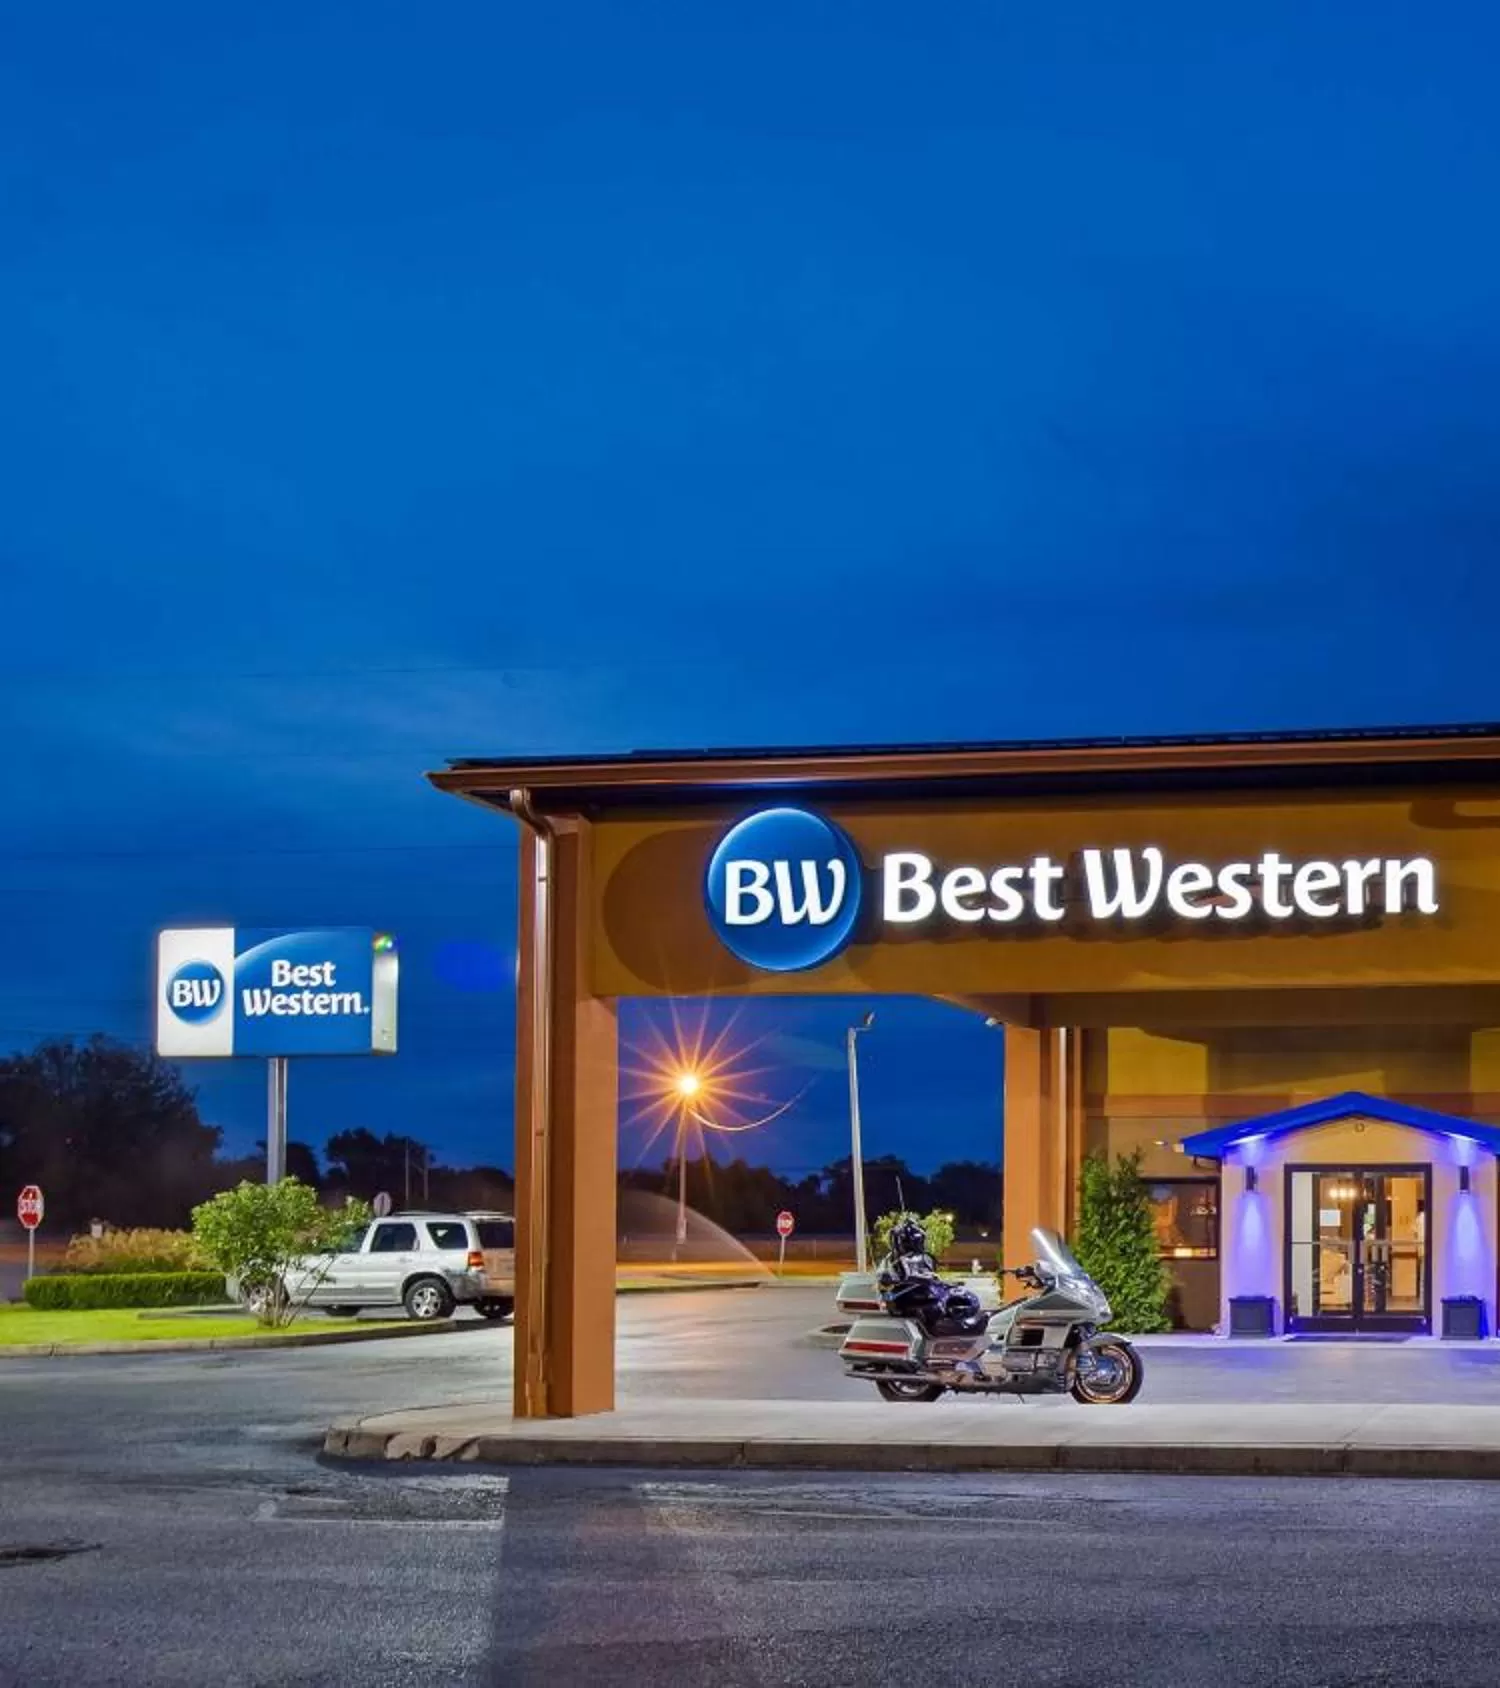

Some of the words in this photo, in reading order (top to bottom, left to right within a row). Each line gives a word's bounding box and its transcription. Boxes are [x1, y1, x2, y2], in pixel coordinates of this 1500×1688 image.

[724, 859, 846, 925] BW
[884, 852, 1066, 923] Best
[1083, 848, 1439, 919] Western
[172, 979, 221, 1007] BW
[271, 959, 337, 987] Best
